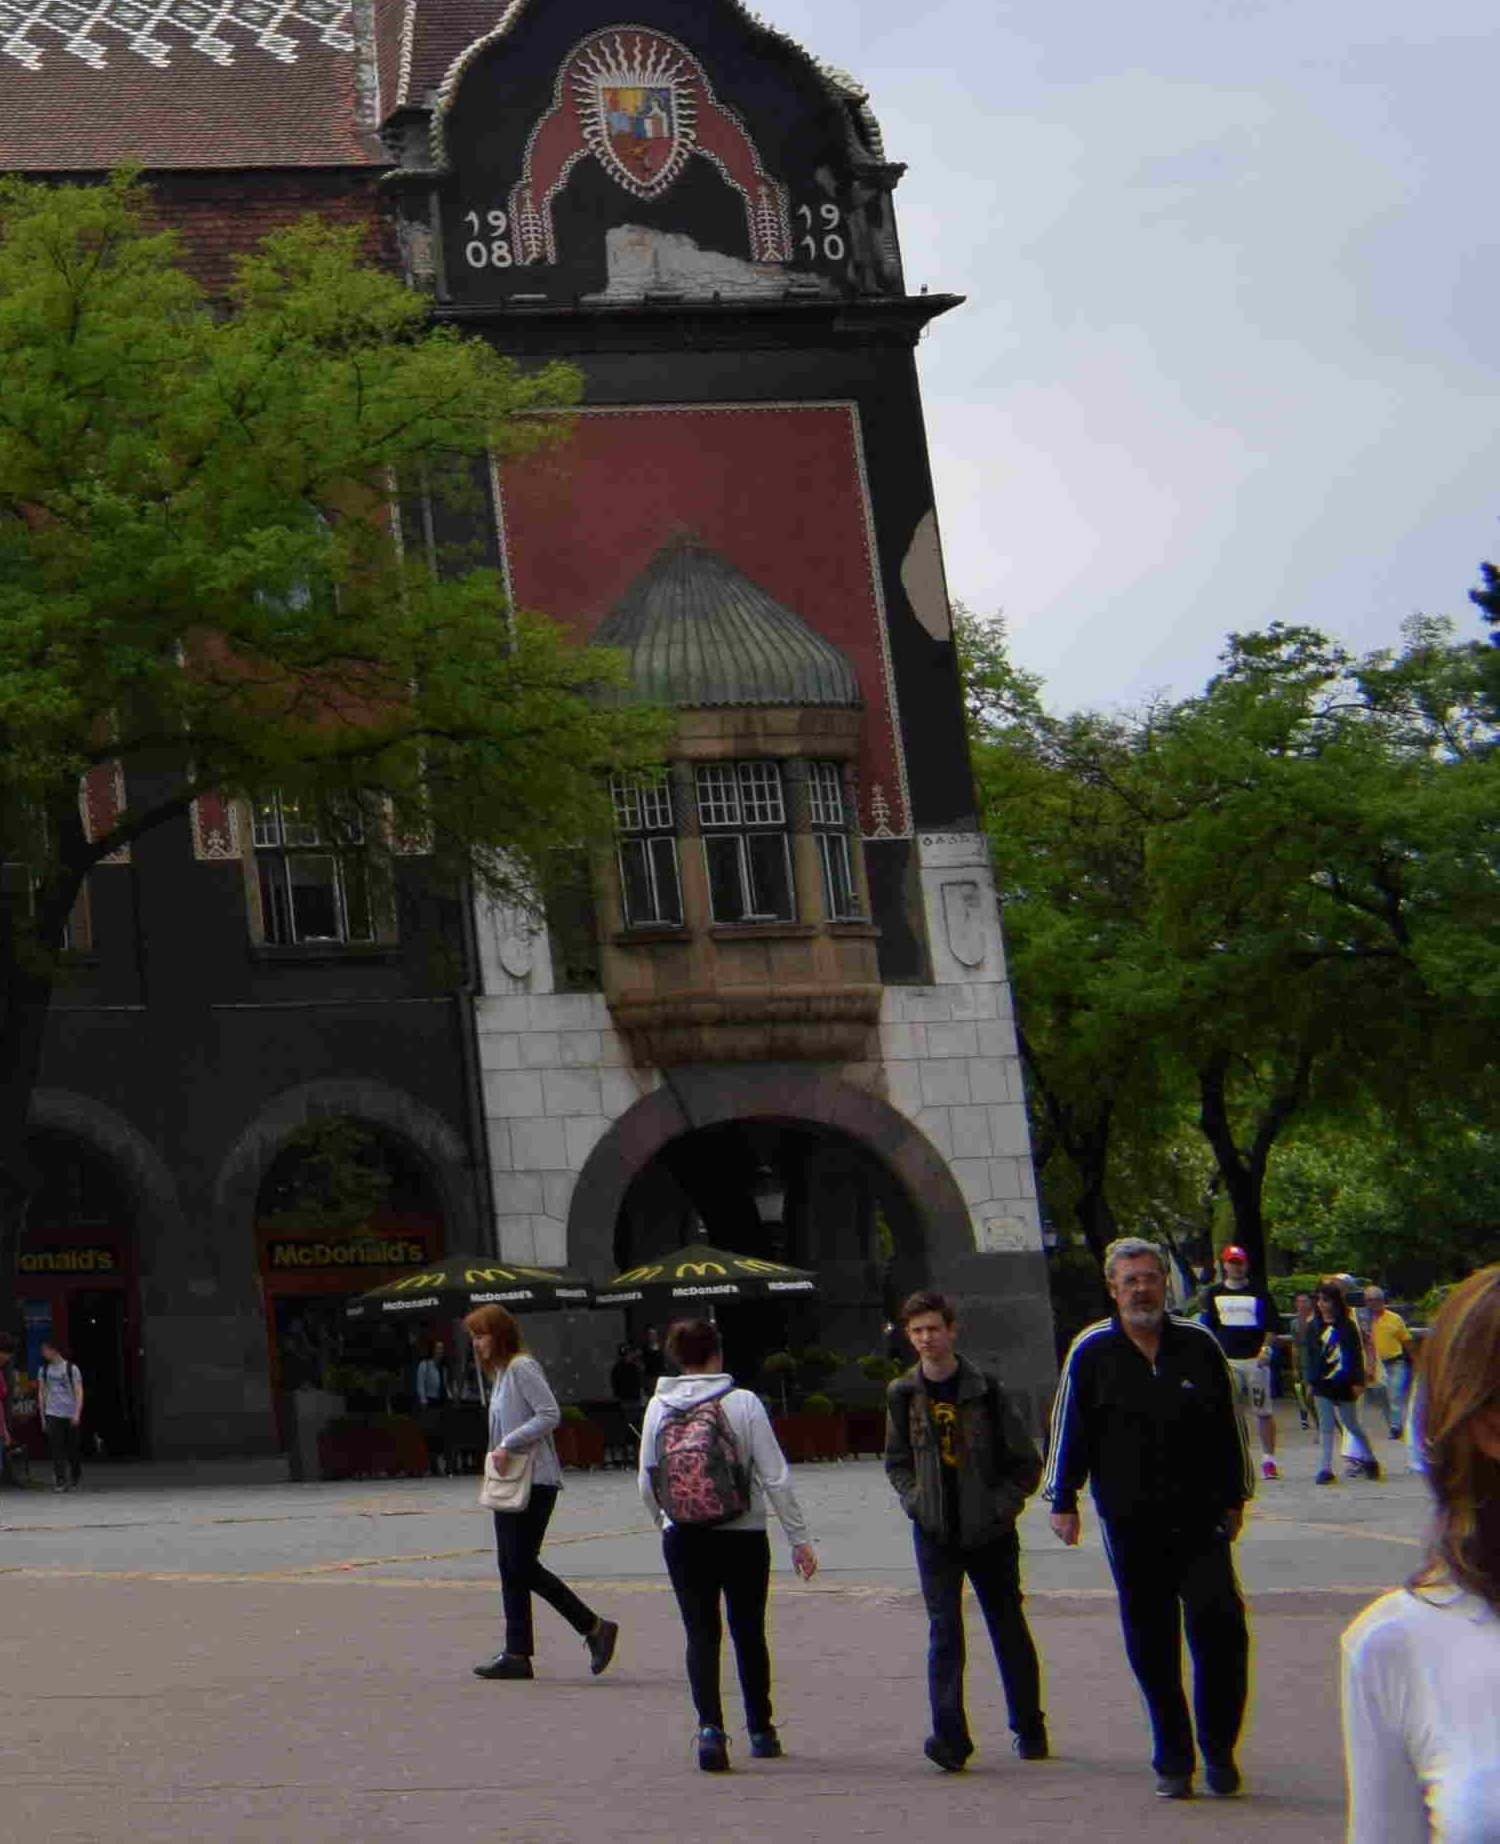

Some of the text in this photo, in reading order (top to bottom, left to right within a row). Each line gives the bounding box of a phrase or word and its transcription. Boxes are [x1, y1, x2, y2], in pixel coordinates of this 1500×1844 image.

[465, 211, 507, 236] 19
[798, 204, 840, 230] 19
[466, 241, 512, 267] 08
[800, 235, 844, 260] 10
[273, 1240, 424, 1268] McDonald's
[469, 1289, 532, 1302] McDonald's
[672, 1284, 739, 1297] McDonald's
